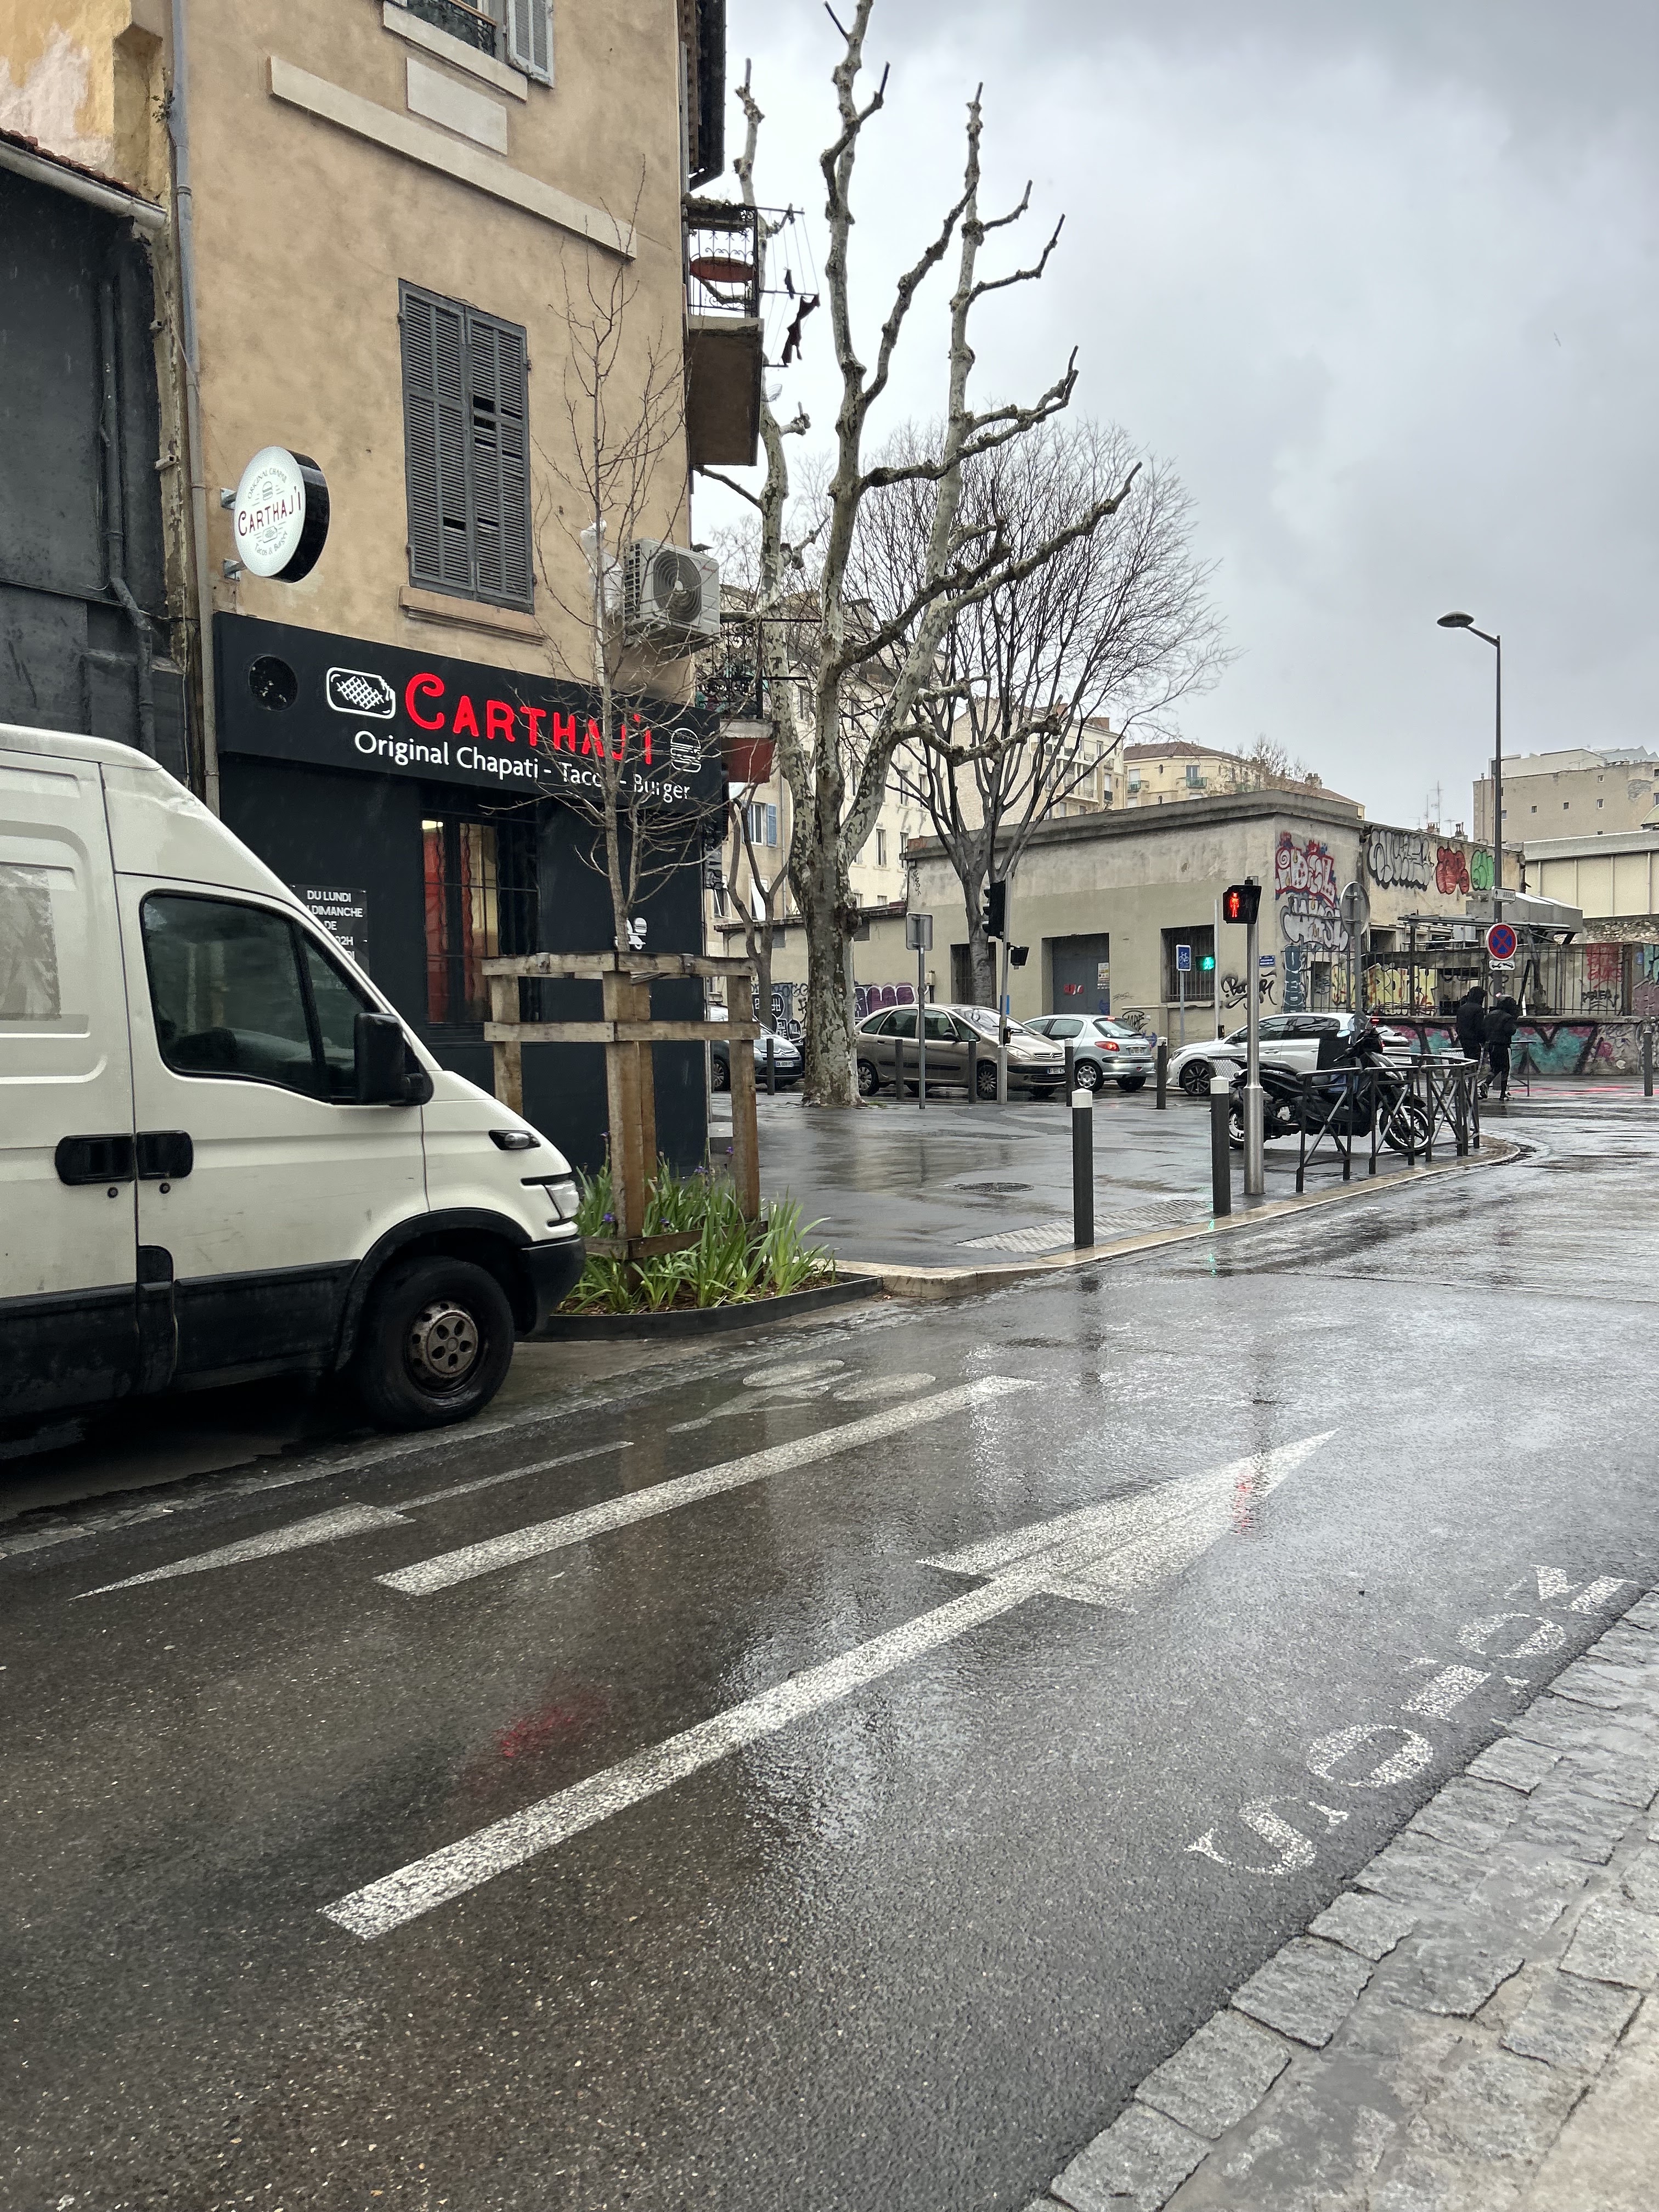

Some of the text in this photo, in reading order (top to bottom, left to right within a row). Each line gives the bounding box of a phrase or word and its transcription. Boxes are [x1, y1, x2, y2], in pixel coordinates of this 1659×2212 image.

[354, 730, 449, 766] Original
[456, 746, 538, 780] Chapati
[307, 890, 352, 902] DU LUNDI
[311, 905, 363, 918] DIMANCHE
[324, 920, 337, 930] DE
